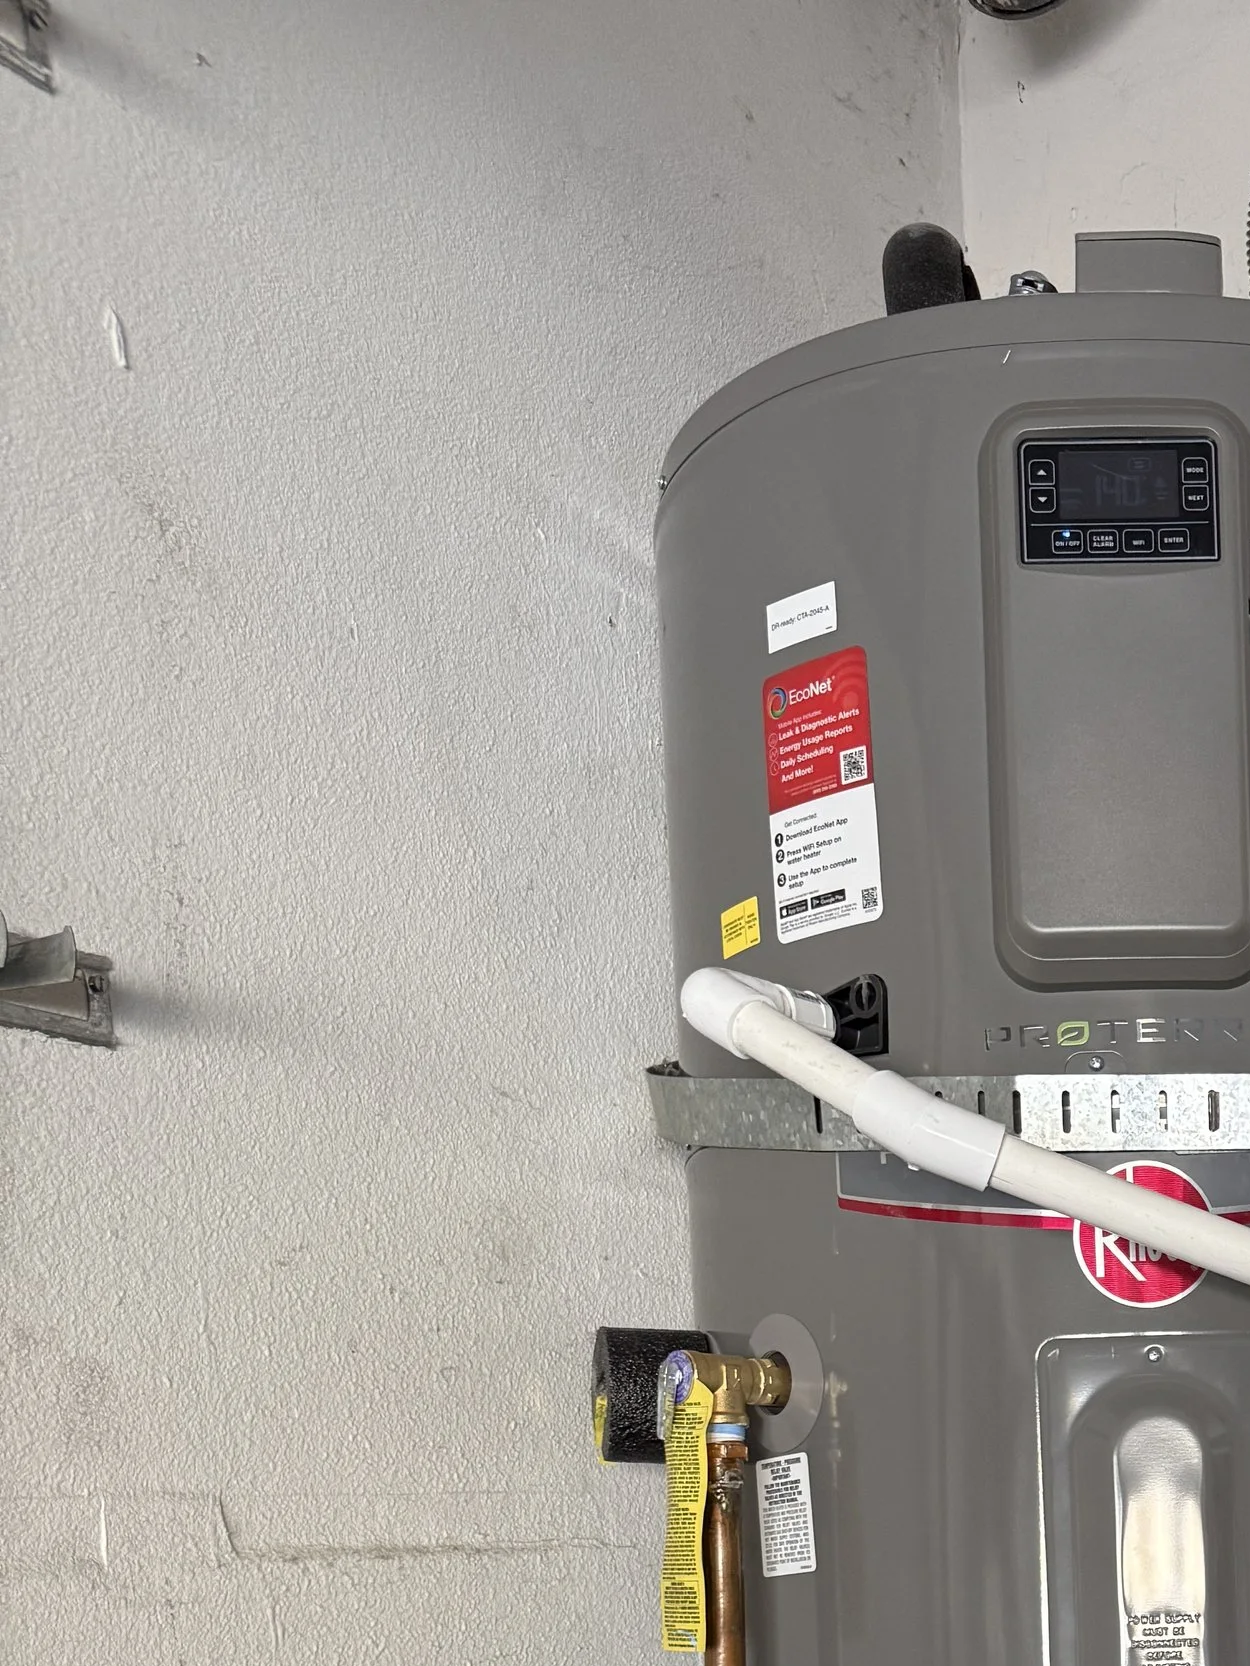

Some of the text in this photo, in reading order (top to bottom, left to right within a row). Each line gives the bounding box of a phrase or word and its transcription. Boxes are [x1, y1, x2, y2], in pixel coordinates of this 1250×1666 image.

[796, 604, 829, 622] CTA-2045-A
[789, 678, 832, 706] EcoNet
[778, 729, 794, 741] Leak
[801, 715, 837, 734] Diagnostic
[838, 708, 859, 720] Alerts
[780, 725, 852, 756] Energy Usage Reports
[780, 745, 833, 770] Daily Scheduling
[781, 765, 814, 783] And More!
[785, 828, 812, 841] Download
[813, 821, 834, 833] EcoNet
[835, 818, 848, 827] App
[787, 848, 801, 858] Press
[816, 838, 833, 850] Setup
[787, 850, 821, 865] water heater
[788, 873, 799, 881] Use
[800, 869, 808, 877] the
[810, 865, 821, 876] App
[829, 857, 857, 870] complete
[789, 880, 804, 889] setup
[1142, 1627, 1185, 1636] MUST BE
